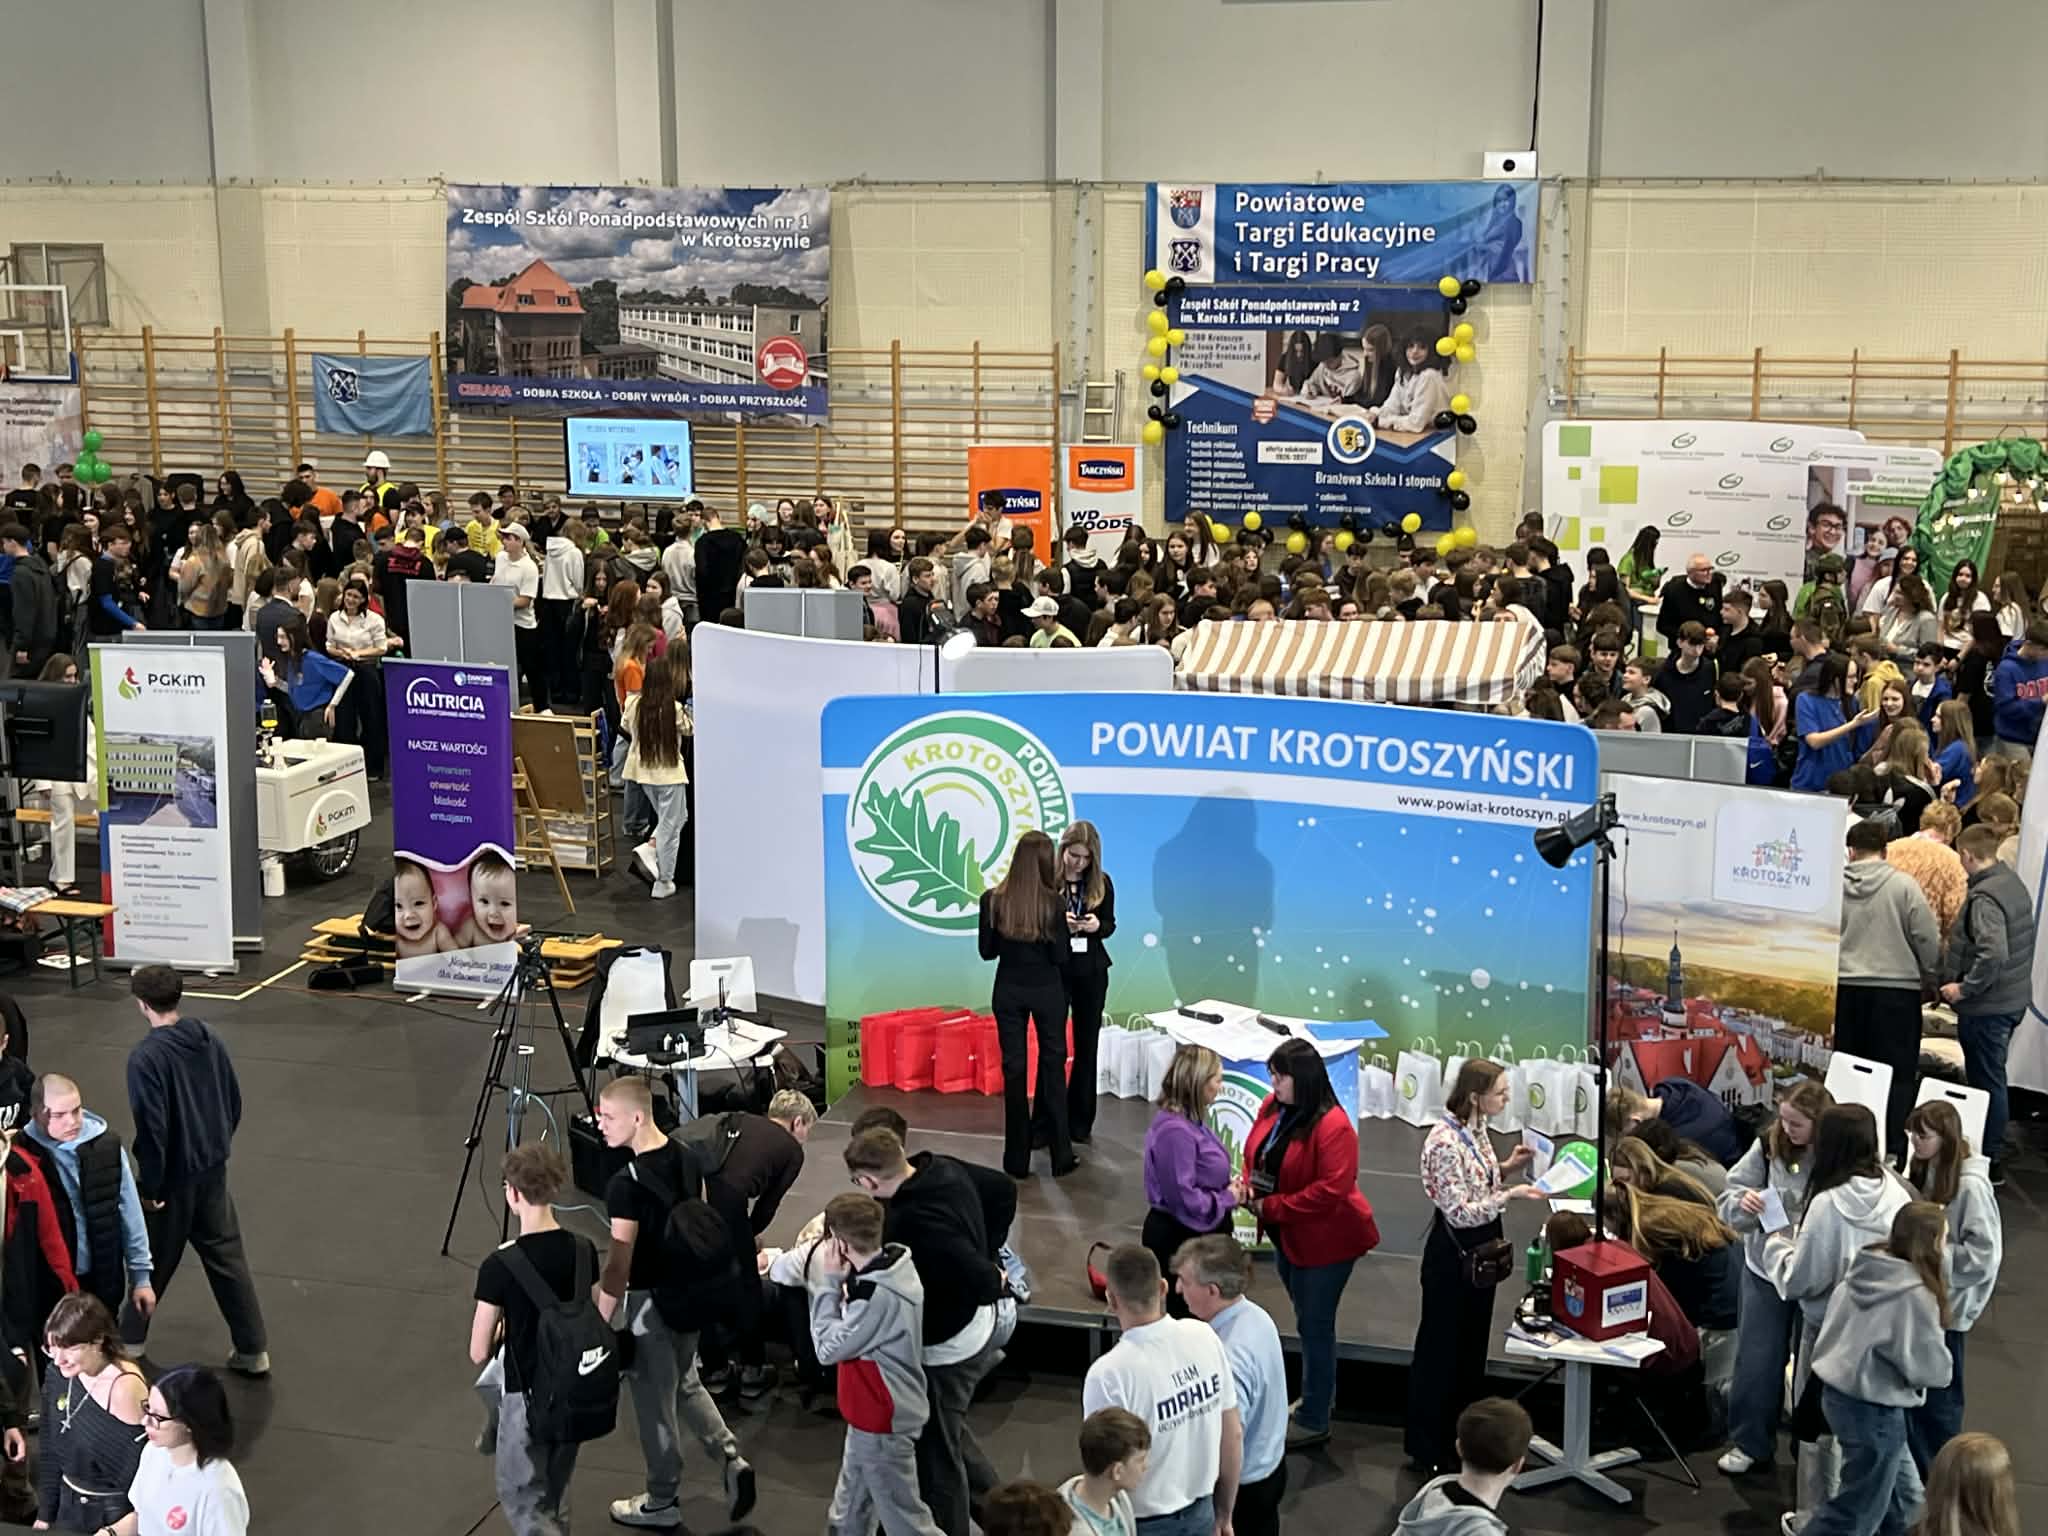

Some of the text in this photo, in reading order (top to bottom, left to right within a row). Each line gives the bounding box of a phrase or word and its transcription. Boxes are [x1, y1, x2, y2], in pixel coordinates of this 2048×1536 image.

[1235, 191, 1365, 213] Powiatowe
[463, 208, 810, 233] Zespół Szkół Ponadpodstawowych nr 1
[681, 231, 811, 253] w Krotoszynie
[1234, 221, 1436, 248] Targi Edukacyjne
[1234, 252, 1380, 279] i Targi Pracy
[1180, 298, 1360, 313] Zespół Szkół Ponadpodstawowych nr 2
[1180, 312, 1340, 326] im. Karola F. Libelta w Krotoszynie
[523, 388, 559, 399] DOBRA
[561, 389, 602, 400] SZKOŁA
[612, 391, 649, 402] DOBRY
[650, 391, 690, 404] WYBÓR
[700, 395, 736, 405] DOBRA
[739, 394, 808, 408] PRZYSZŁOŚĆ
[1187, 421, 1238, 434] Technikum
[1080, 464, 1124, 476] TARCZYŃSKI
[1315, 471, 1362, 486] Branżowa
[1364, 472, 1397, 487] Szkoła
[1405, 475, 1442, 489] stopnia
[1071, 510, 1099, 521] WD
[413, 691, 484, 712] NUTRICIA
[408, 739, 488, 755] NASZE WARTOŚCI
[1090, 720, 1575, 791] POWIAT KROTOSZYŃSKI
[1398, 795, 1572, 823] www.powiat-krotoszyn.pl
[1733, 866, 1811, 887] KROTOSZYN
[1171, 1364, 1200, 1388] TEAM
[1157, 1373, 1220, 1420] MAHLE
